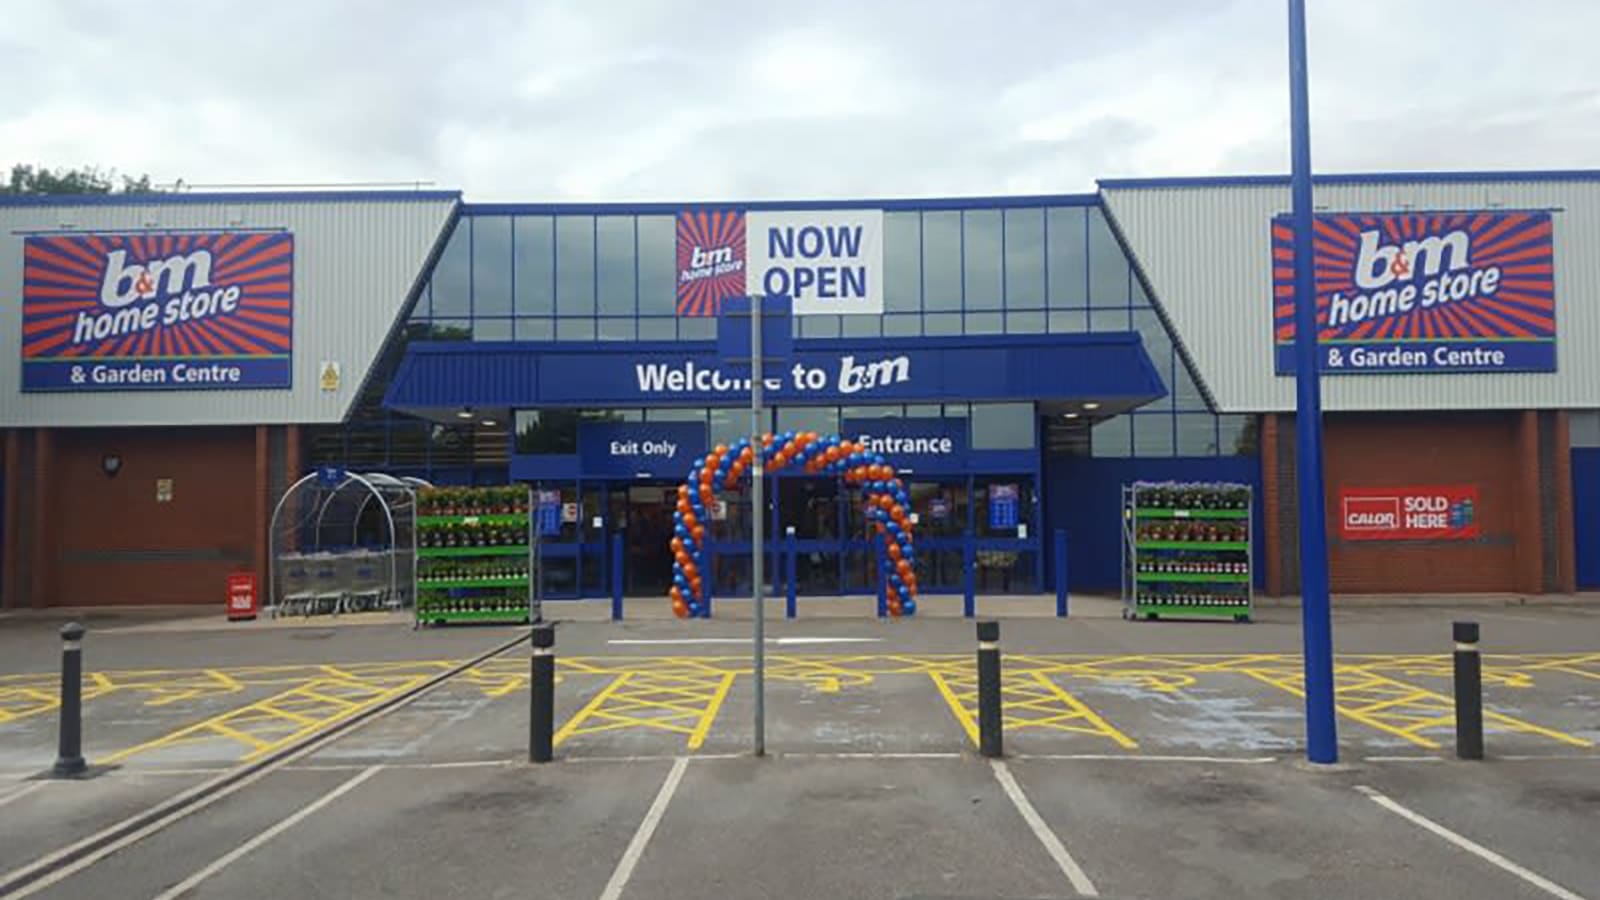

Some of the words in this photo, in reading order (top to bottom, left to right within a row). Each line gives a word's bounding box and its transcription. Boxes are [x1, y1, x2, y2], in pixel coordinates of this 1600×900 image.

[768, 225, 863, 258] NOW
[1355, 230, 1472, 289] b&m
[101, 250, 213, 307] b&m
[763, 266, 866, 298] OPEN
[1328, 286, 1415, 326] home
[1421, 266, 1499, 307] store
[73, 304, 158, 344] home
[164, 285, 240, 325] store
[1328, 349, 1343, 367] &
[1350, 347, 1427, 367] Garden
[1434, 346, 1505, 366] Centre
[71, 366, 86, 383] &
[92, 364, 166, 383] Garden
[172, 363, 241, 382] Centre
[636, 361, 783, 391] Welcoe
[792, 363, 826, 390] to
[610, 441, 638, 455] Exit
[642, 441, 676, 458] Only
[859, 434, 952, 453] Entrance
[1404, 497, 1448, 511] SOLD
[1349, 513, 1394, 528] CALOR
[1405, 514, 1448, 528] HERE
